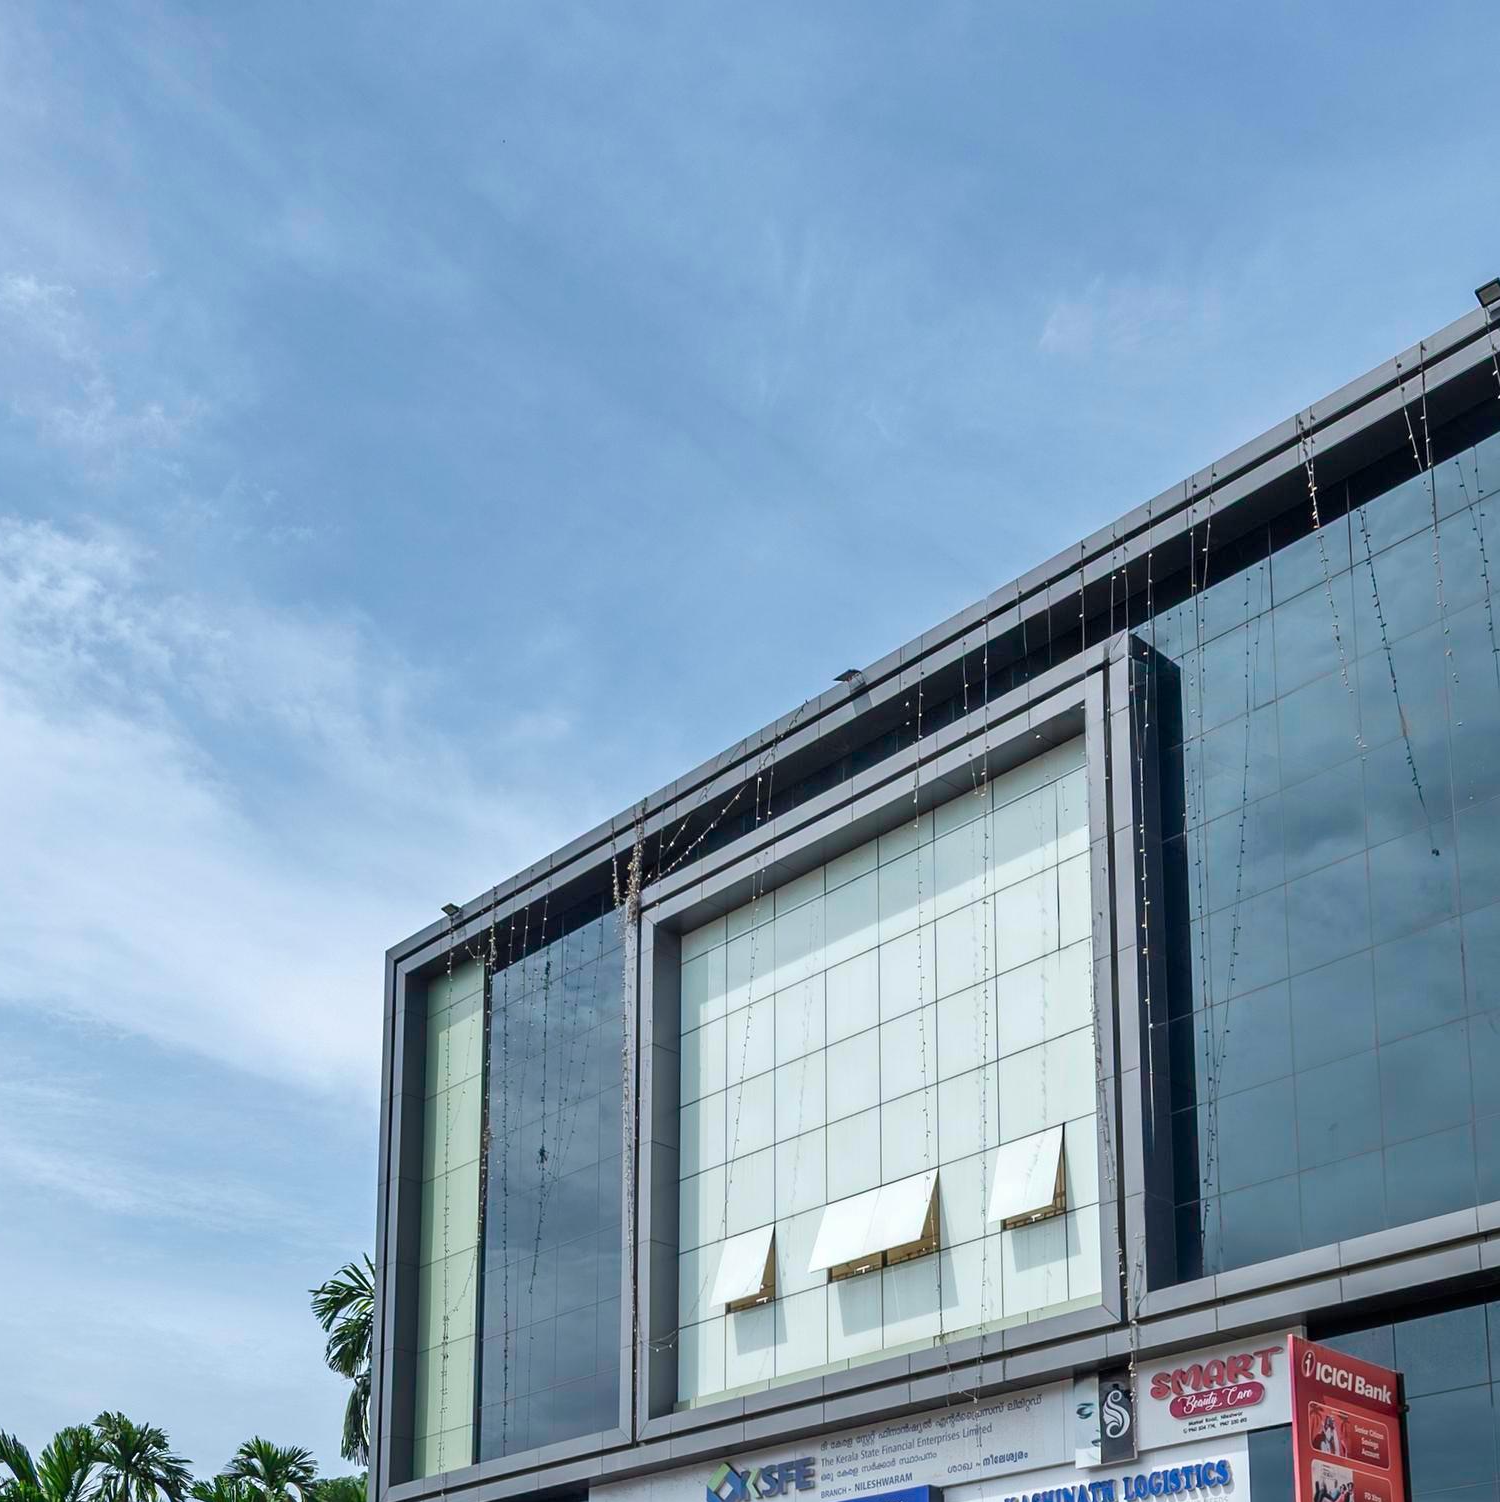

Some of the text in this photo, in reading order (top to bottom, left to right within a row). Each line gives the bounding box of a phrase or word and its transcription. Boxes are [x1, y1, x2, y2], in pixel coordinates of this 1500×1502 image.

[1149, 1345, 1284, 1401] SMART
[1316, 1362, 1392, 1404] ICICI Bank
[1178, 1386, 1253, 1415] Beauty Care
[821, 1423, 993, 1467] The Kerala State Financial Enterprises Limited
[1361, 1448, 1380, 1459] Account
[820, 1472, 913, 1499] BRANCH NILESHWARAM
[948, 1463, 973, 1474] ശാഖ
[1123, 1460, 1231, 1501] LOGISTICS
